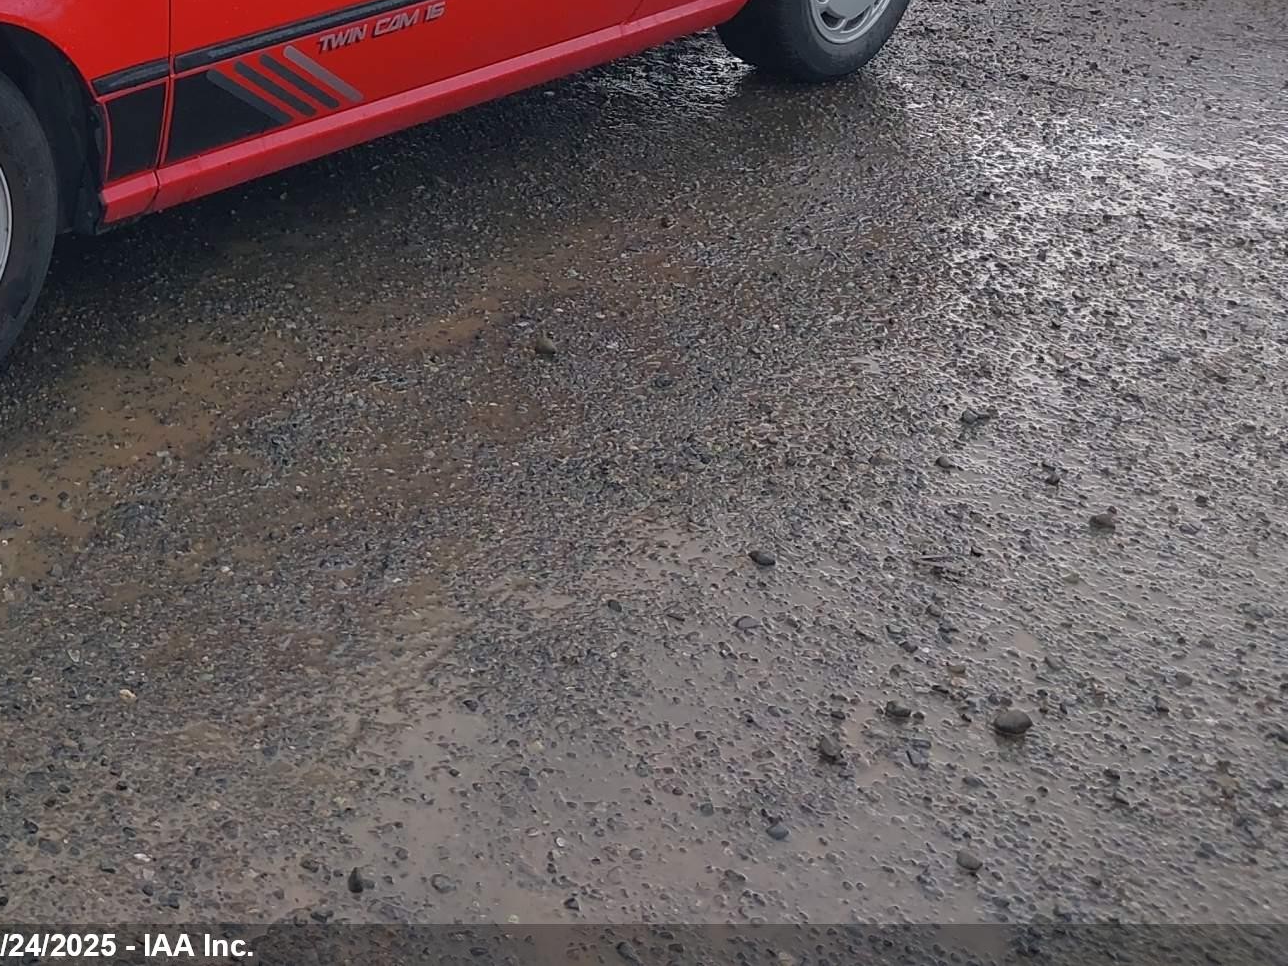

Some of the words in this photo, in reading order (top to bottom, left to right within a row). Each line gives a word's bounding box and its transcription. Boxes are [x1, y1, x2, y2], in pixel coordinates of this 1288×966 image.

[318, 25, 368, 53] TWIN
[373, 9, 420, 36] CAM
[425, 2, 446, 21] 16
